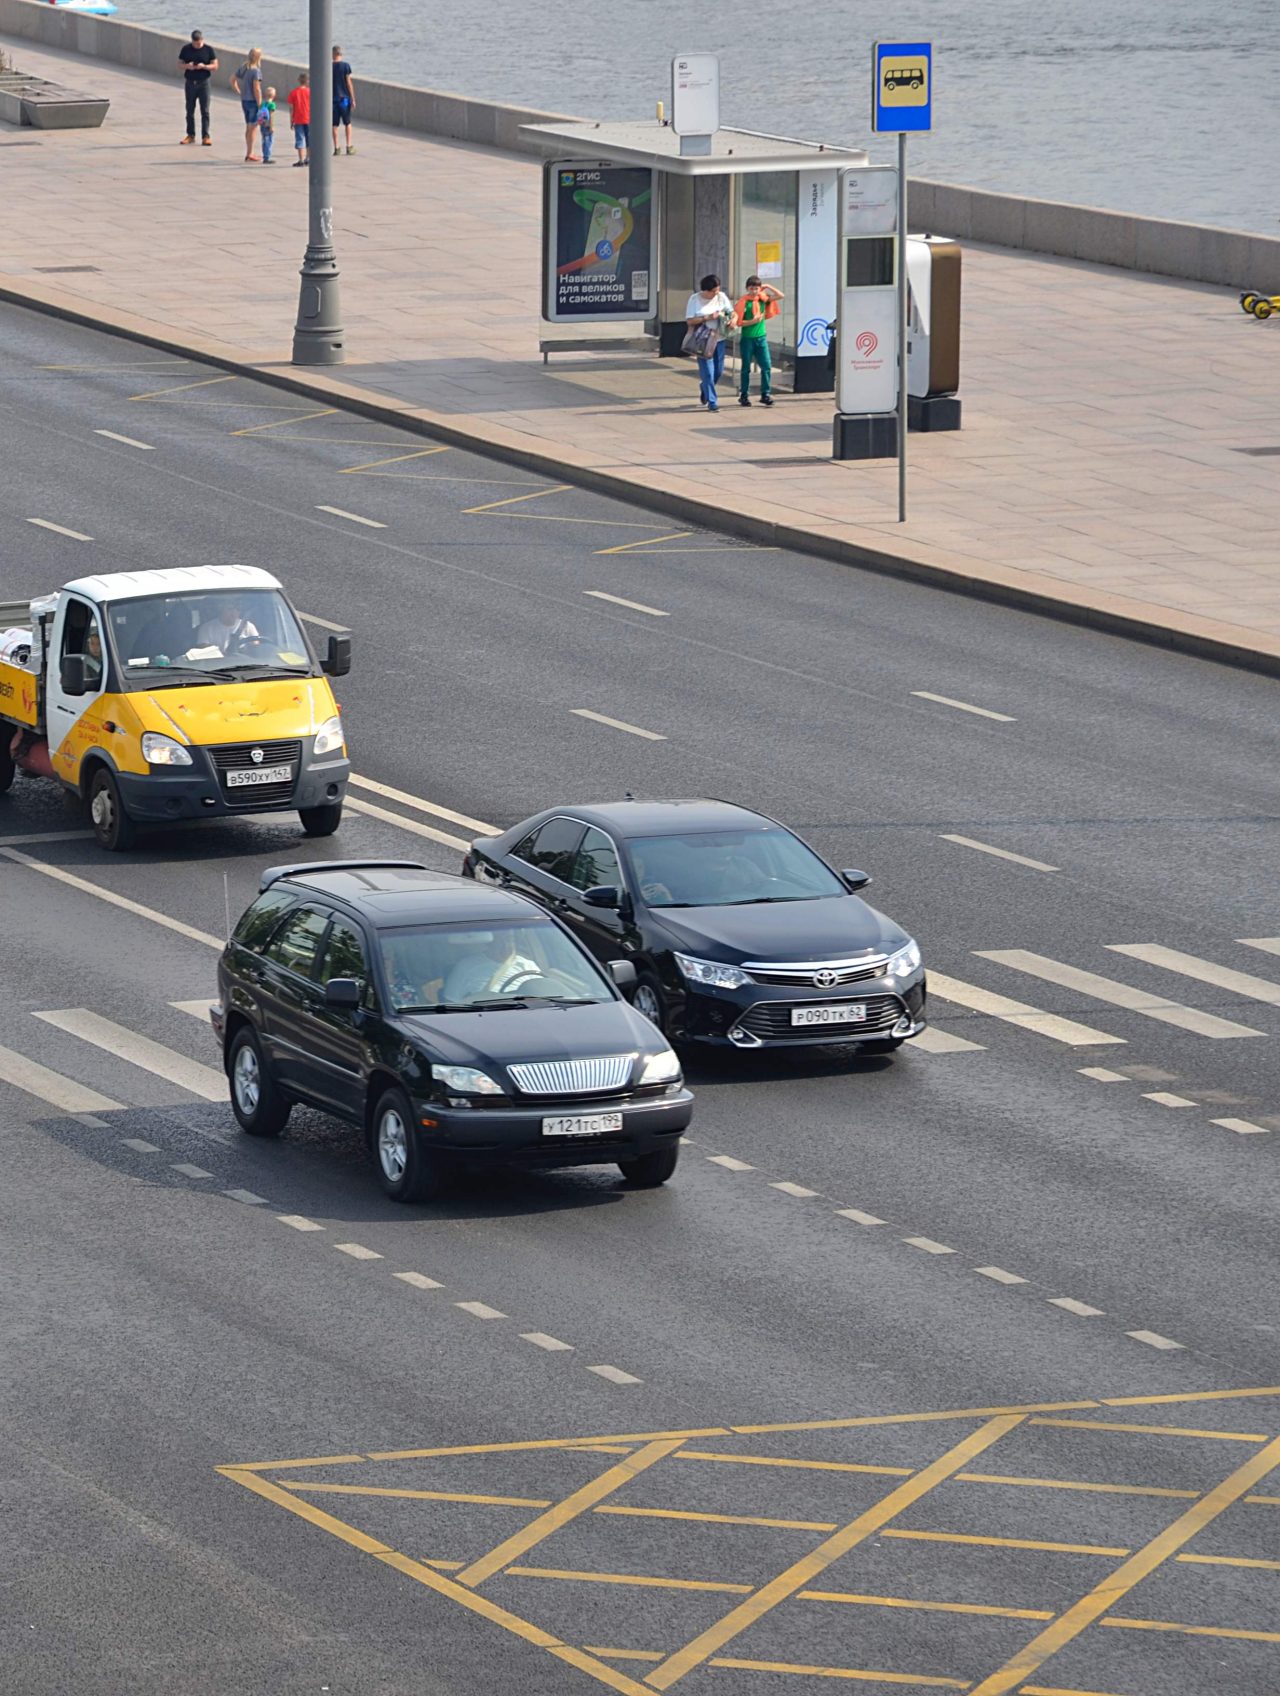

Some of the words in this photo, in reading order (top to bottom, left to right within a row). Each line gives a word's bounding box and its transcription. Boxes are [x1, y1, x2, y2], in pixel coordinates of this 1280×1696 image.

[576, 171, 601, 181] 2ГИС
[559, 273, 617, 283] Навигатор
[559, 285, 579, 294] для
[581, 283, 625, 293] великов
[559, 296, 566, 304] и
[568, 294, 625, 303] самокатов
